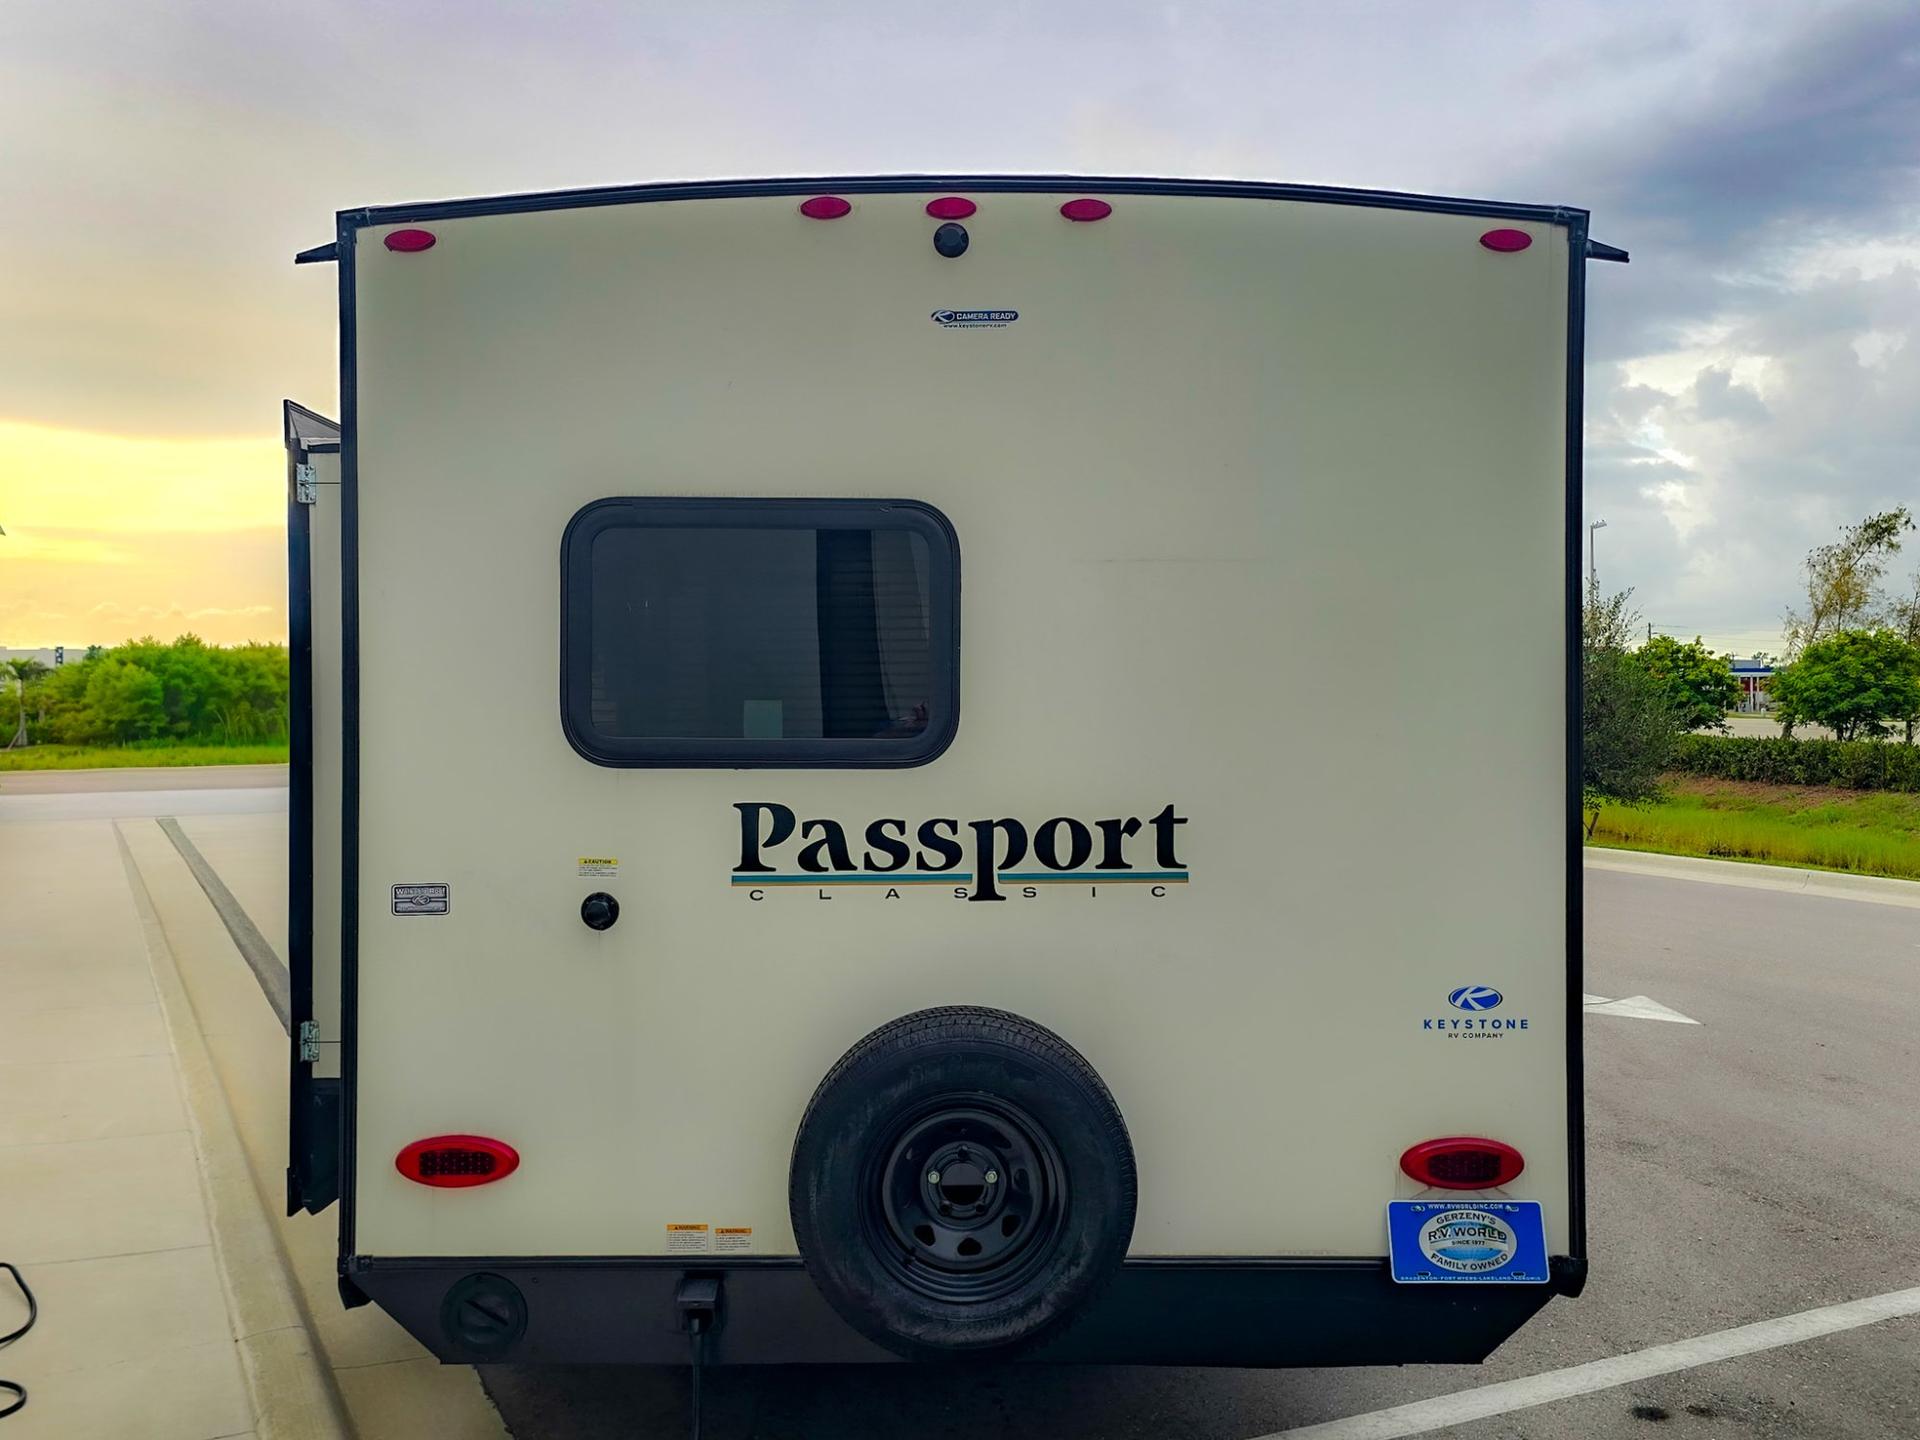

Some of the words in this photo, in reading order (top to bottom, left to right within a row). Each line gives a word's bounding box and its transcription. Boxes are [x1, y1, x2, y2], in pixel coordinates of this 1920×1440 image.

[732, 802, 1189, 901] Passport
[749, 886, 1166, 900] CLASSIC
[1423, 1019, 1528, 1029] KEYSTONE
[1436, 1211, 1497, 1225] GERZENY'S
[1428, 1228, 1451, 1240] R.V.
[1453, 1226, 1507, 1240] WORLD
[1430, 1253, 1467, 1270] FAMILY
[1470, 1253, 1509, 1271] OWNED
